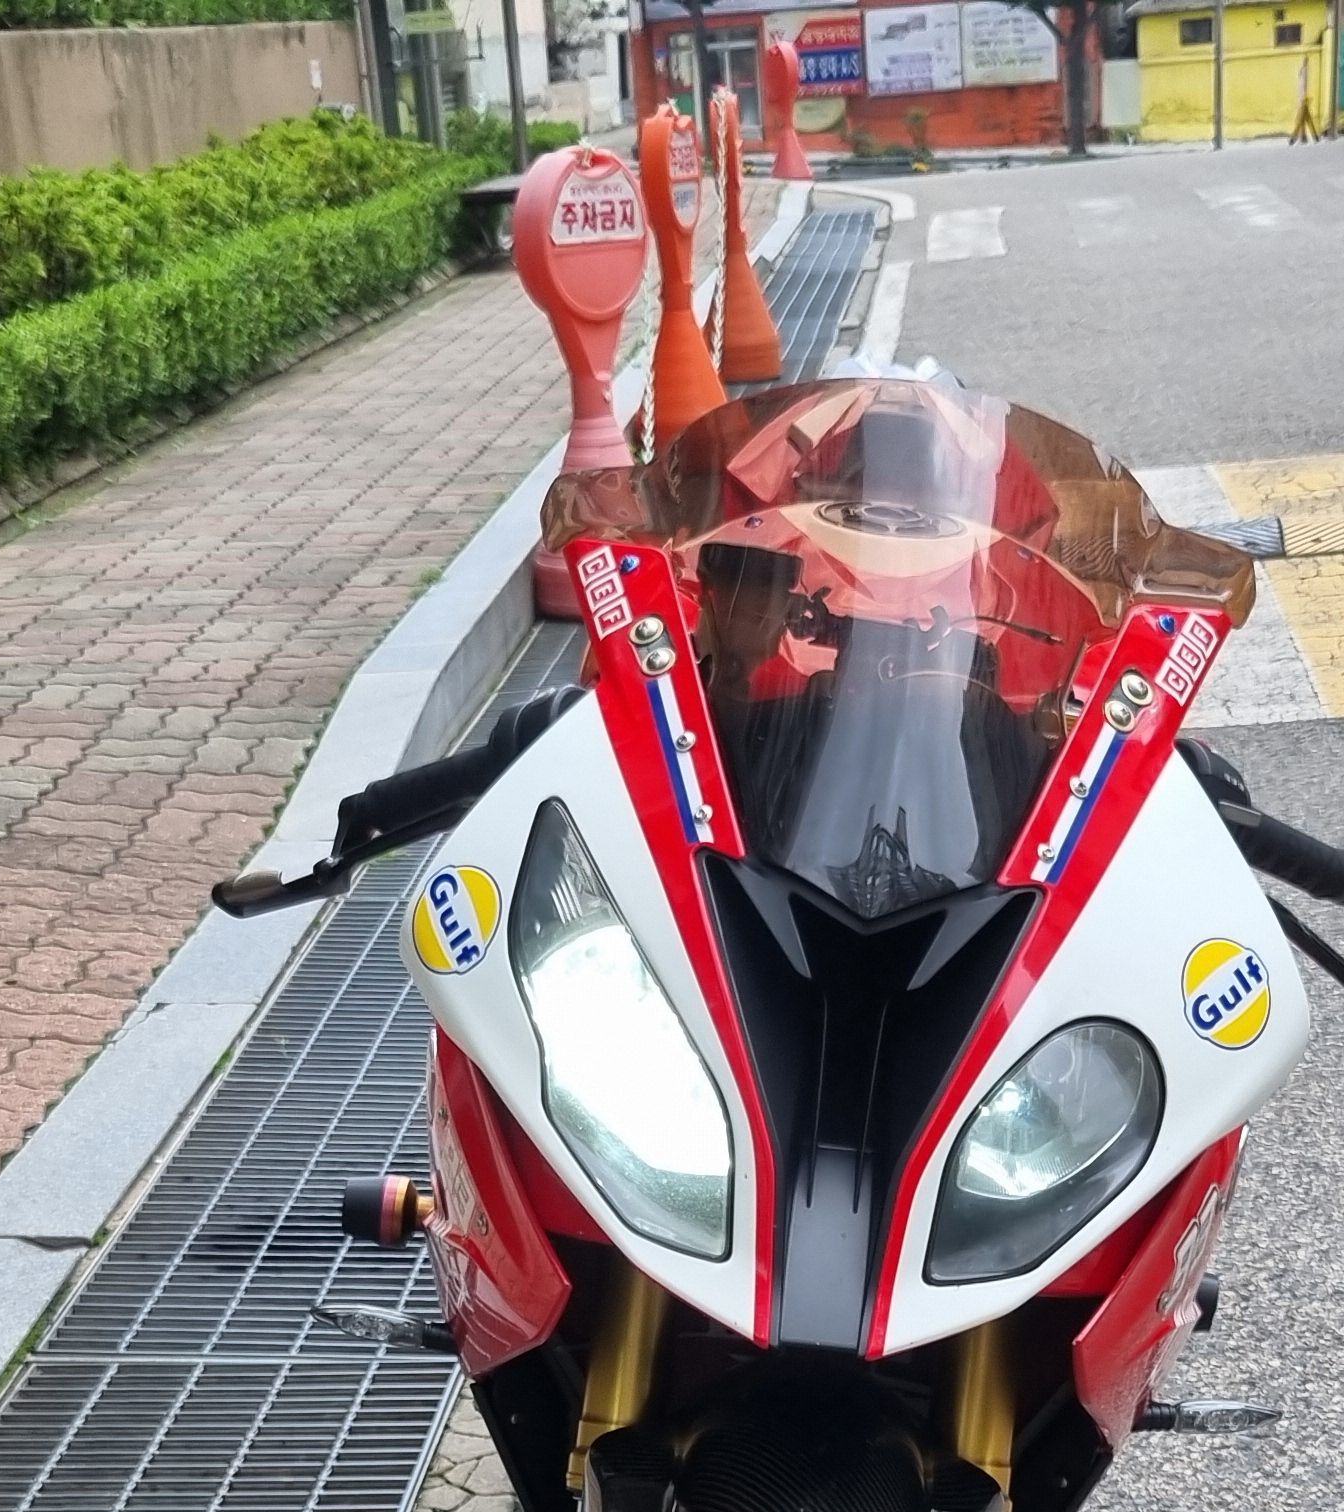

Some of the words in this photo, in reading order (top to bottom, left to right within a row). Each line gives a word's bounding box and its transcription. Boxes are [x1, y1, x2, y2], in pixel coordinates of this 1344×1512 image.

[561, 199, 636, 235] 주차금지
[583, 555, 627, 630] CEF
[430, 873, 481, 967] Gulf
[1191, 955, 1264, 1031] Gulf
